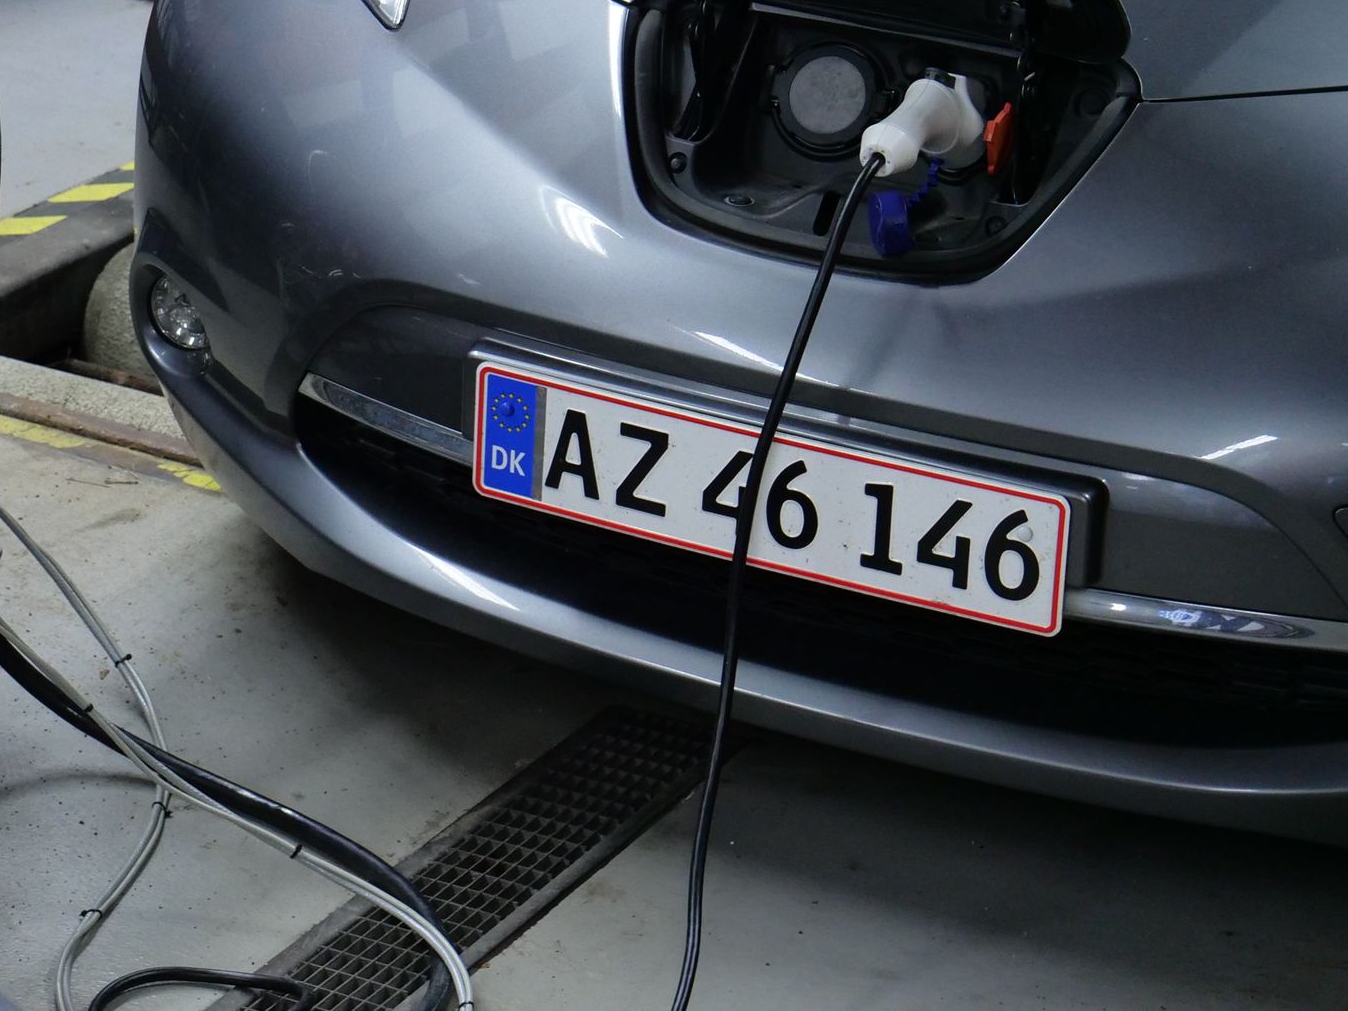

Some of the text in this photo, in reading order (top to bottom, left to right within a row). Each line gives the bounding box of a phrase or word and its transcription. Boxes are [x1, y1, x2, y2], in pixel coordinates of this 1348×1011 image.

[491, 445, 526, 477] DK
[544, 408, 1041, 601] AZ 46 146
